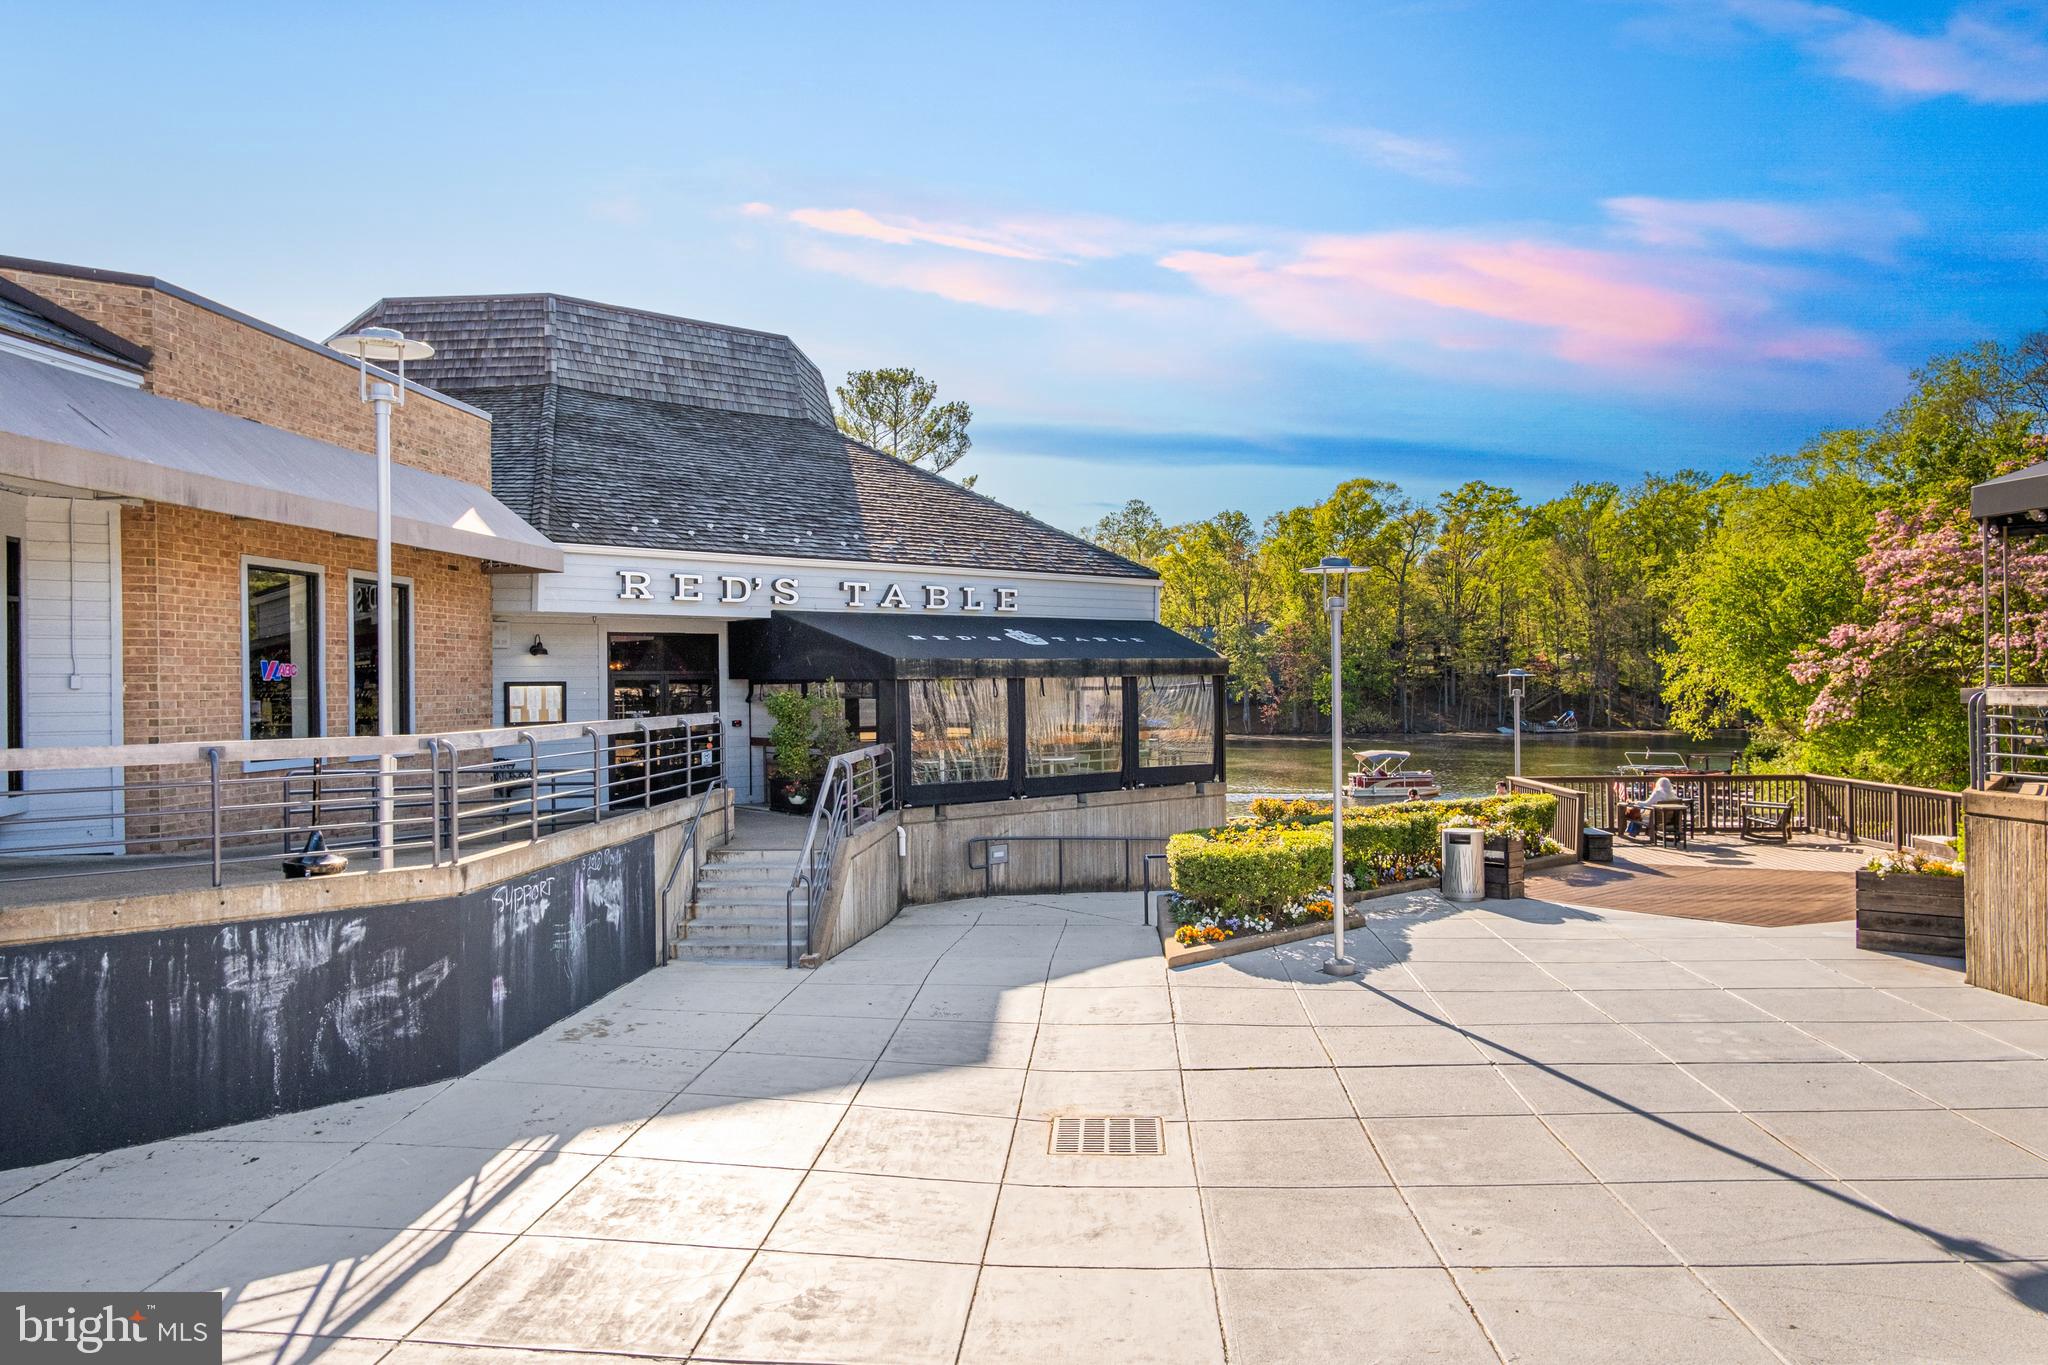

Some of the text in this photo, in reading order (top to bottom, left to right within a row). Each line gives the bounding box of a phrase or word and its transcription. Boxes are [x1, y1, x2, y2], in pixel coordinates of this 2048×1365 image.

[616, 571, 1018, 612] RED'S TABLE
[278, 663, 299, 677] ABC
[492, 877, 555, 913] SUPPORT
